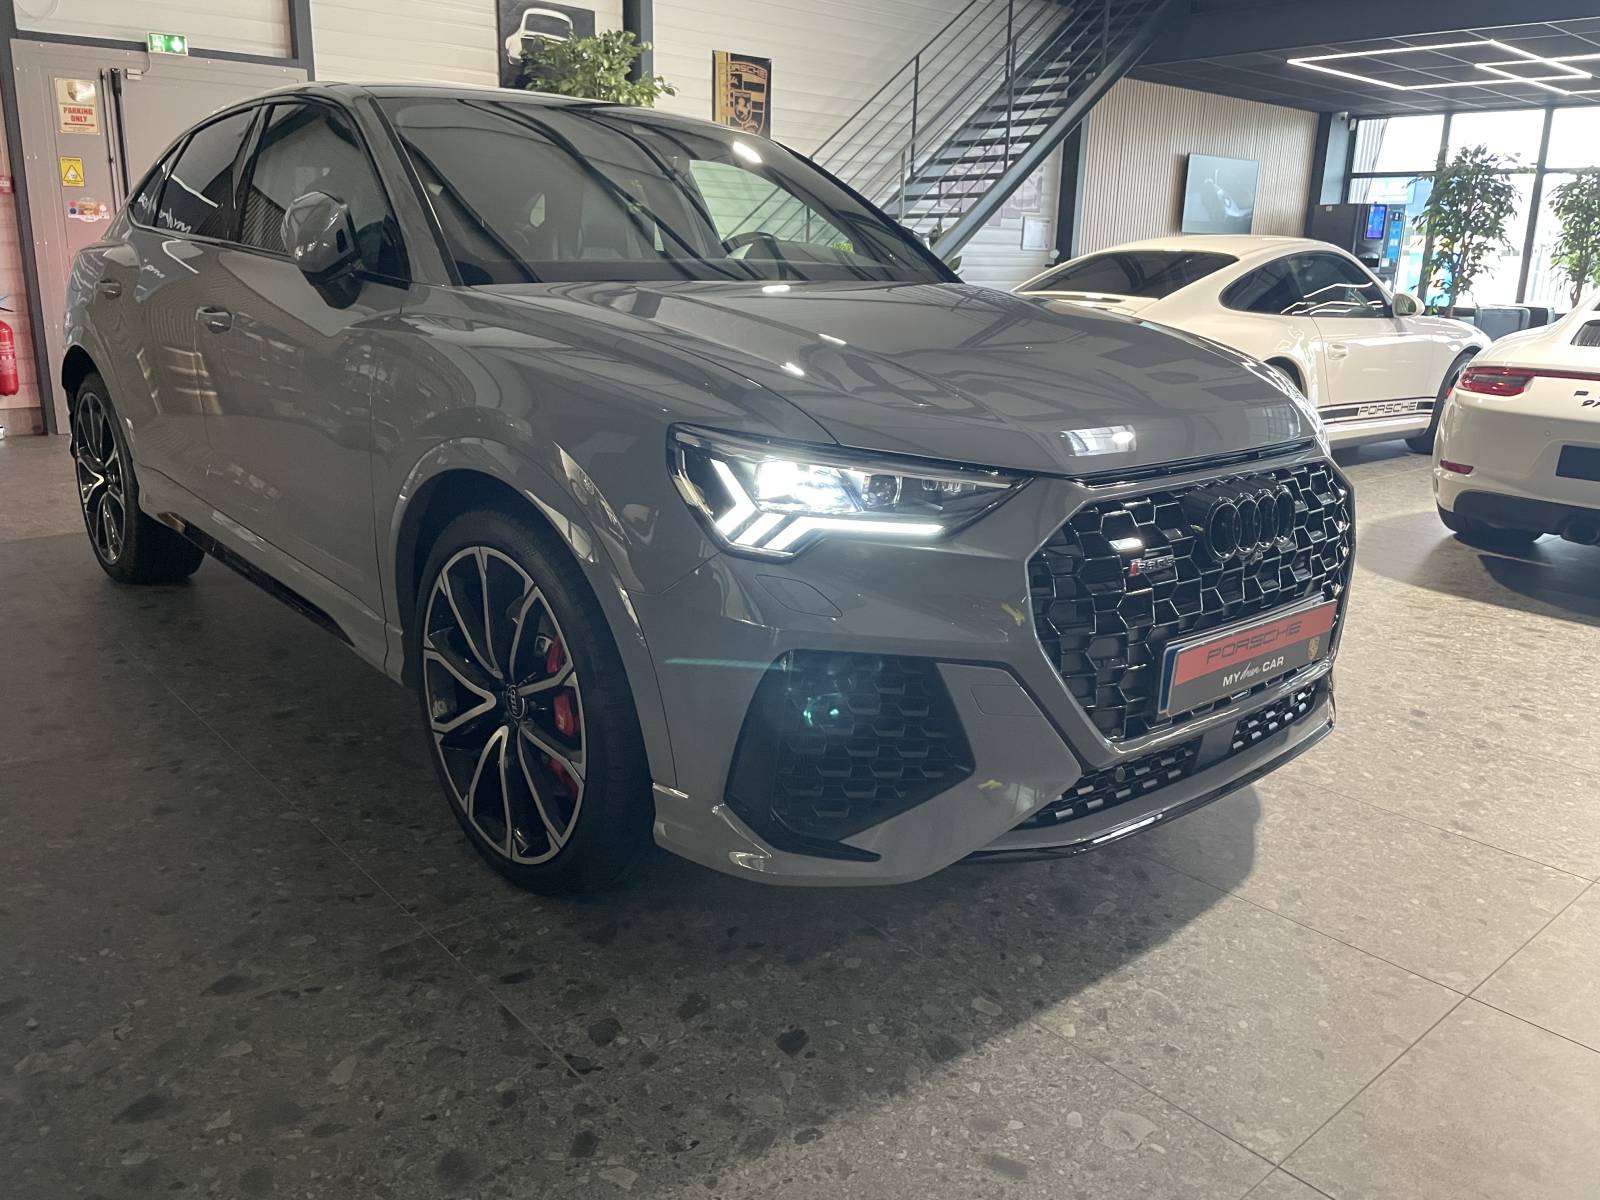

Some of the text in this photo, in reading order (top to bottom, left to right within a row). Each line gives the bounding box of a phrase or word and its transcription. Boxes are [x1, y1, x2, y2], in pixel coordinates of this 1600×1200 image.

[63, 106, 94, 115] PARKING
[1360, 401, 1417, 416] PORSCHE
[1206, 620, 1302, 664] PORSCHE
[1222, 671, 1241, 687] MY
[1262, 655, 1284, 672] CAR
